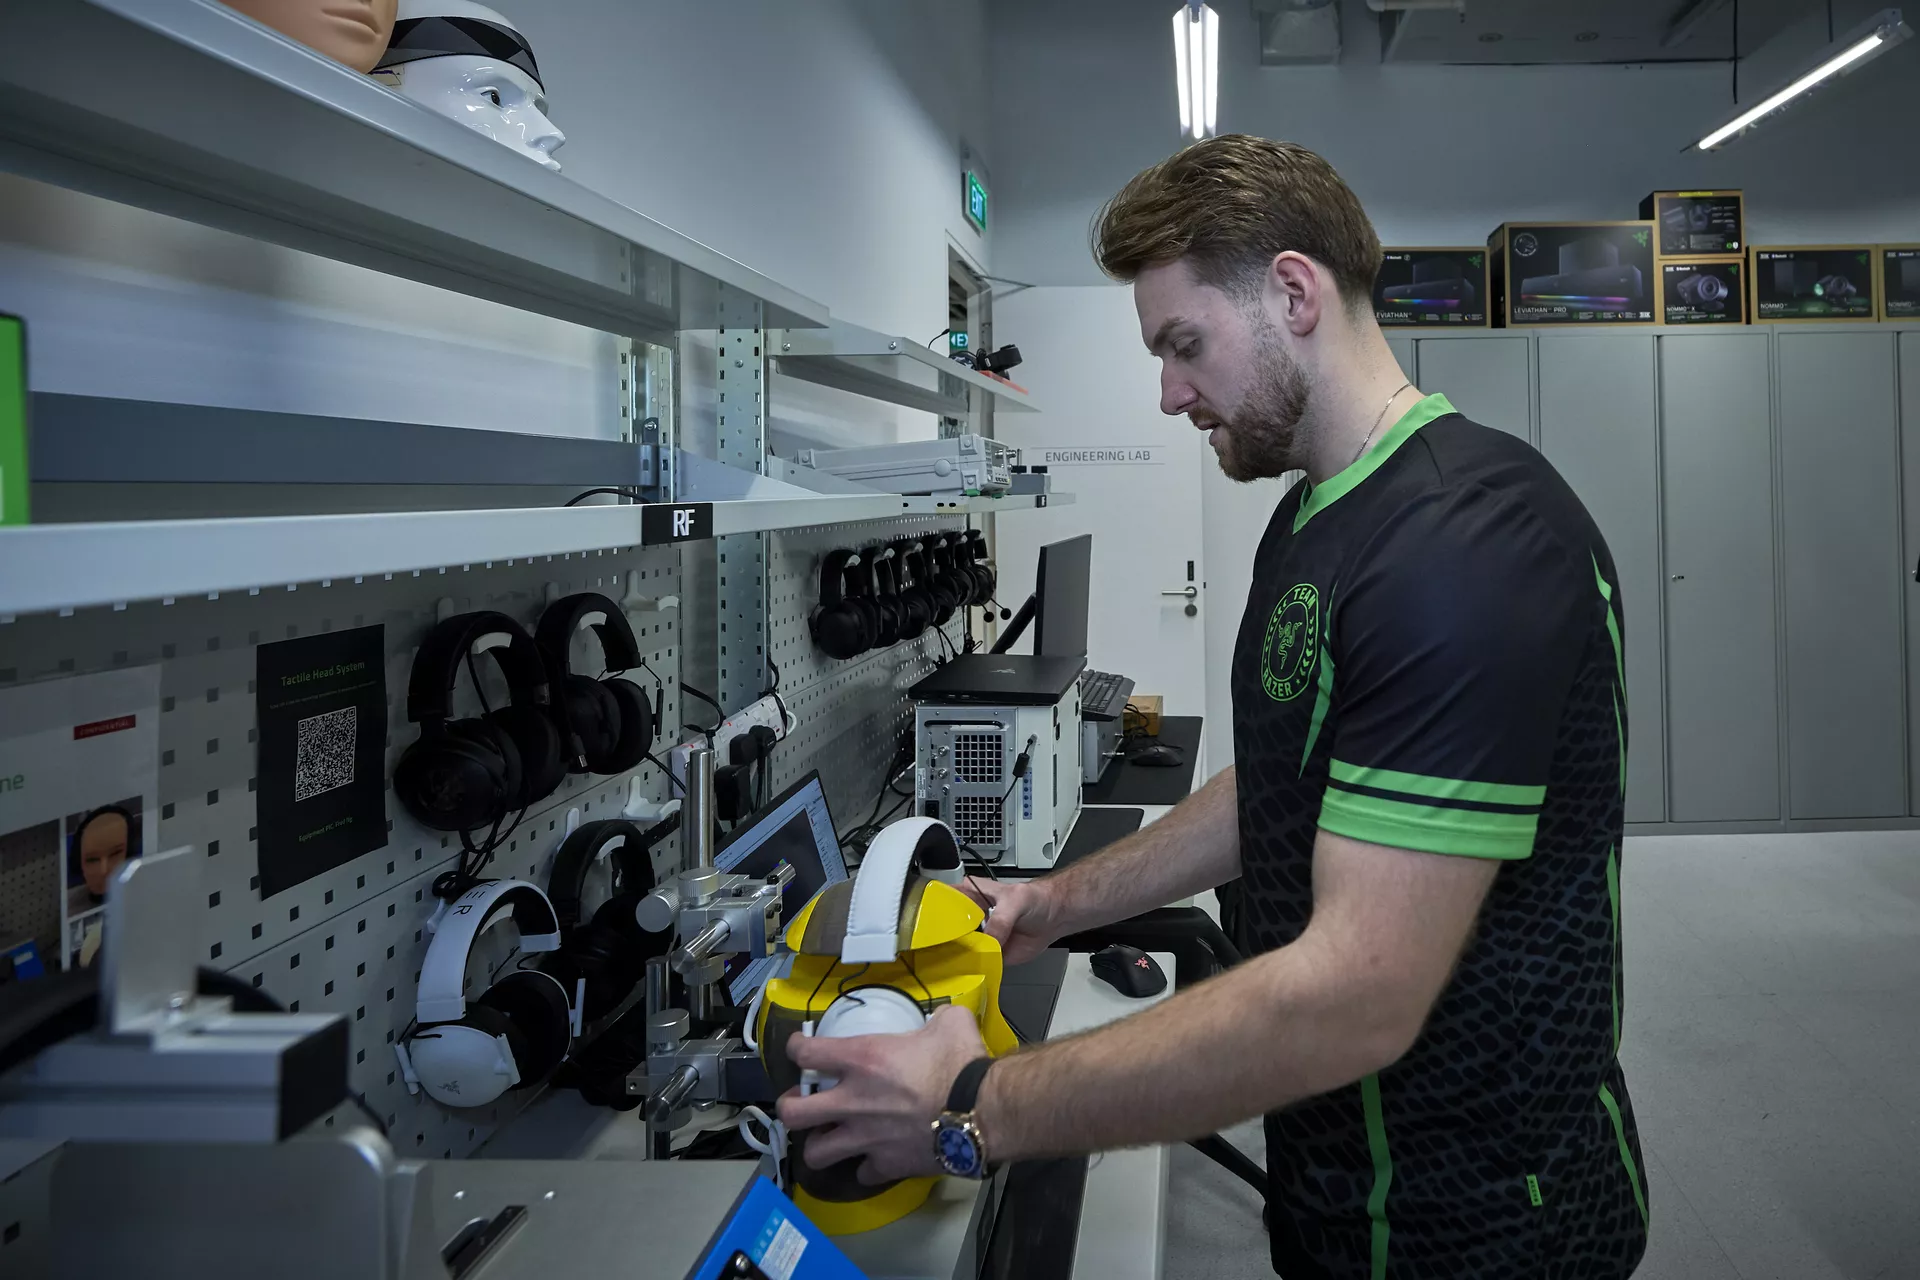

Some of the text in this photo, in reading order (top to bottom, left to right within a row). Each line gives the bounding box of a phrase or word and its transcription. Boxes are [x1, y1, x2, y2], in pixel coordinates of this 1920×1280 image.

[1376, 311, 1409, 319] EVIATHAN
[1514, 306, 1548, 314] LEVIATHAN
[1045, 450, 1151, 462] ENGINEERING LAB
[673, 509, 696, 537] RF
[1293, 587, 1316, 610] TEAM
[281, 661, 365, 687] Tactile Head System
[1263, 668, 1293, 697] RAZER
[452, 881, 499, 916] ZER
